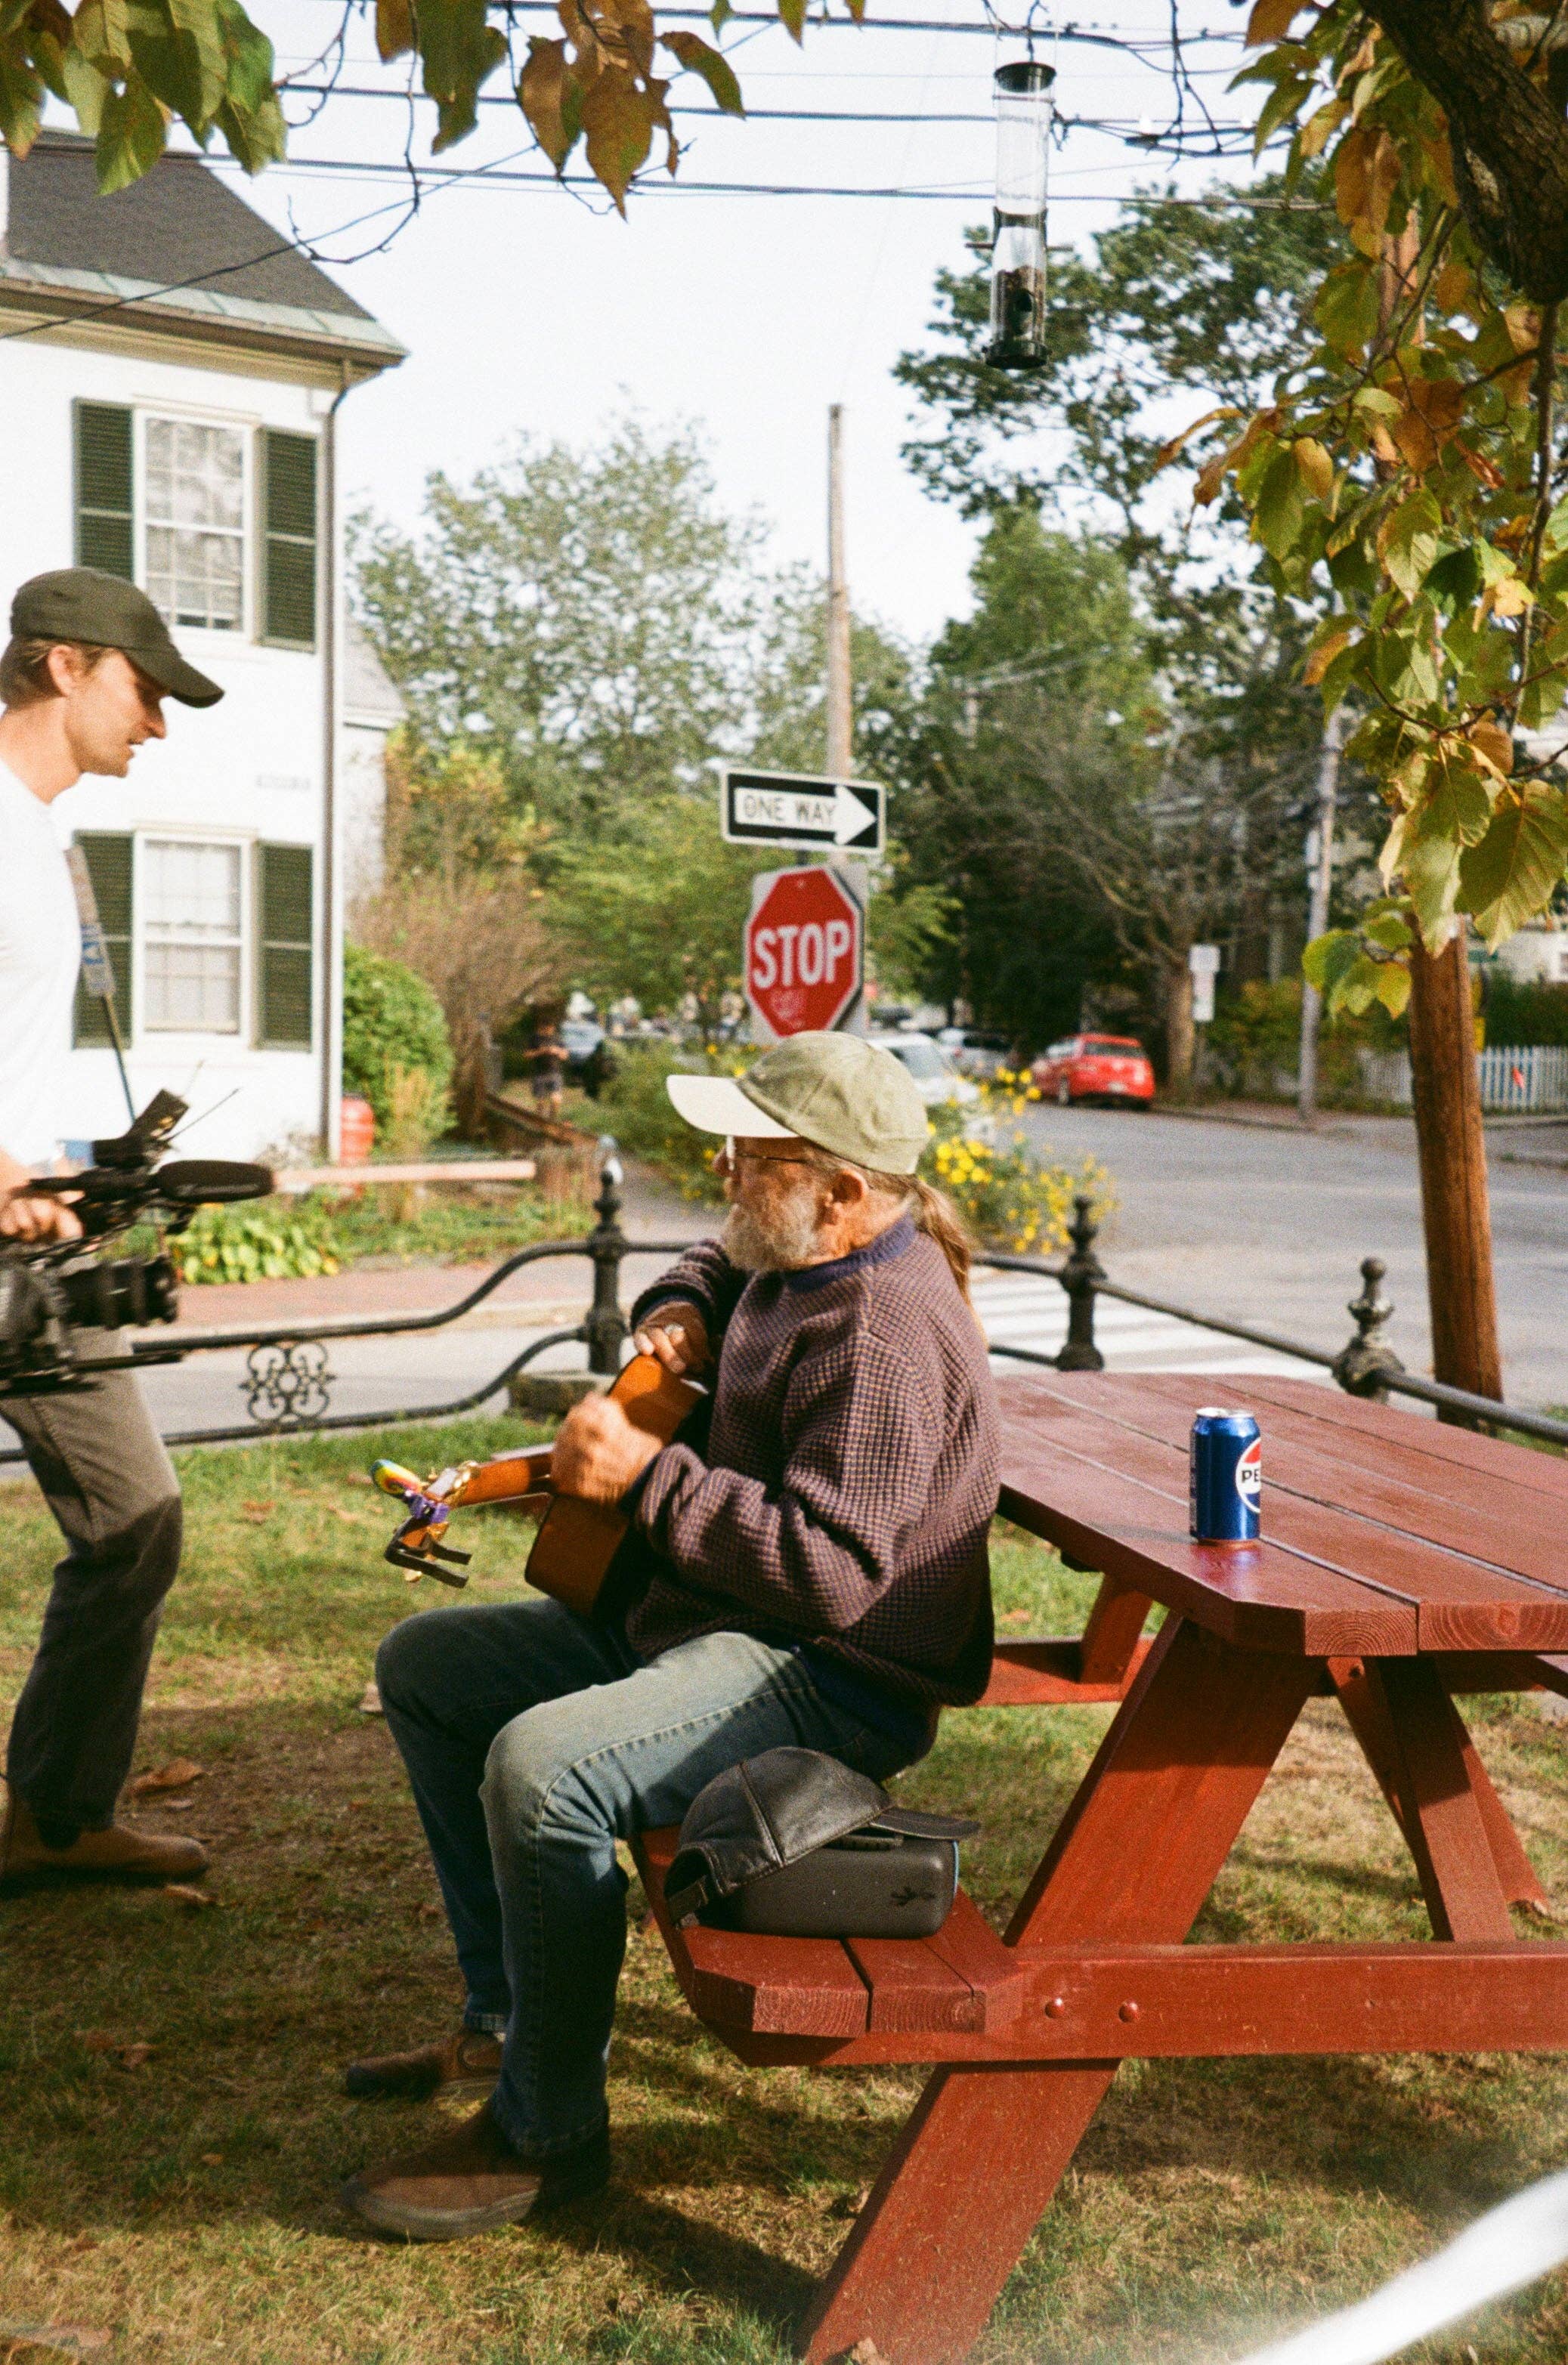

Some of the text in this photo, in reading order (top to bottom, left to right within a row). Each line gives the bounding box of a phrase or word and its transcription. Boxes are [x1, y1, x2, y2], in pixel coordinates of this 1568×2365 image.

[743, 794, 837, 826] ONE WAY
[754, 919, 852, 988] STOP
